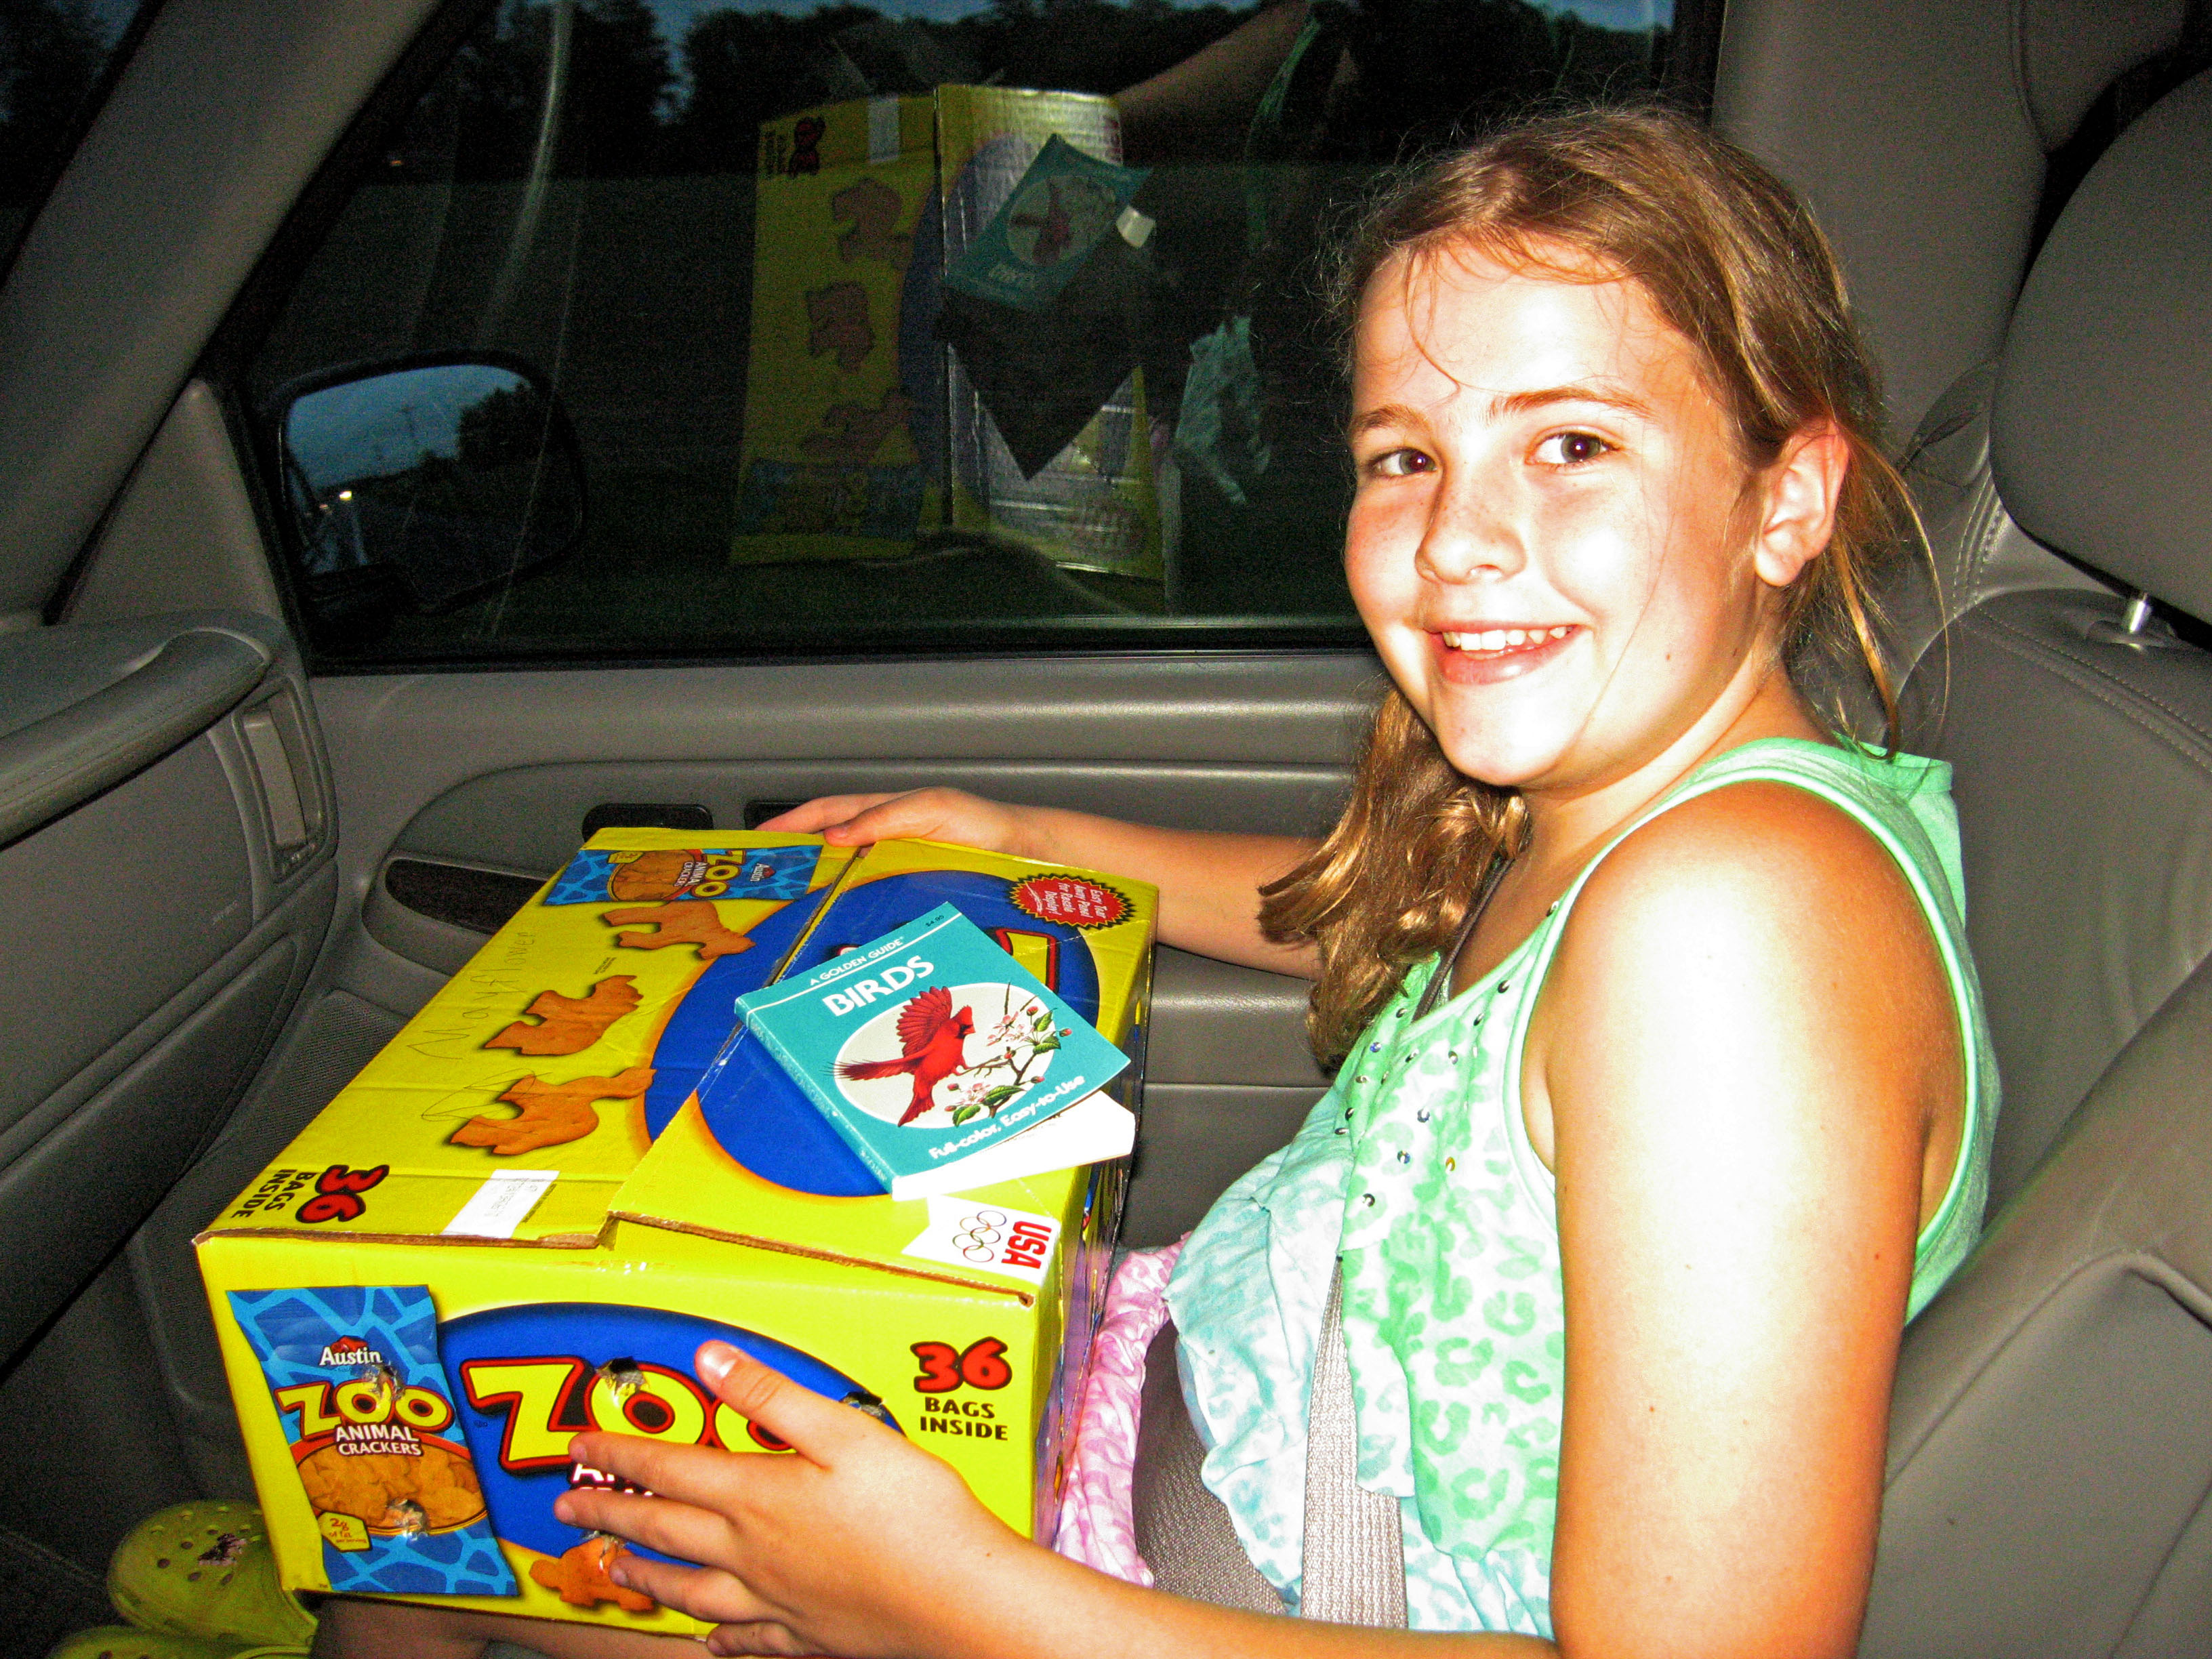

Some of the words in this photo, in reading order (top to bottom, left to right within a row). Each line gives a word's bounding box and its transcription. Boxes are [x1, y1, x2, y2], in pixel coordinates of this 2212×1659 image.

[674, 861, 695, 886] CRACKERS
[684, 861, 709, 886] ANIMAL
[692, 850, 746, 898] ZOO
[750, 863, 771, 881] Austin
[1058, 882, 1070, 892] for
[1073, 884, 1087, 900] Away
[1090, 889, 1104, 904] Easy
[1042, 890, 1062, 915] Display!
[1060, 892, 1076, 912] Resale
[1077, 900, 1094, 918] Panel
[1094, 905, 1108, 918] Tear
[810, 978, 820, 986] A
[819, 956, 867, 980] GOLDEN
[822, 956, 935, 1017] BIRDS
[230, 1169, 298, 1218] INSIDE
[264, 1172, 319, 1211] BAGS
[295, 1164, 390, 1224] 36
[1001, 1221, 1052, 1269] USA
[319, 1347, 383, 1366] Austin
[909, 1336, 1012, 1393] 36
[274, 1380, 455, 1441] ZOO
[459, 1356, 806, 1475] ZO
[924, 1397, 996, 1419] BAGS
[336, 1425, 419, 1443] ANIMAL
[920, 1416, 1008, 1441] INSIDE
[338, 1442, 422, 1456] CRACKERS
[330, 1518, 349, 1531] 2g
